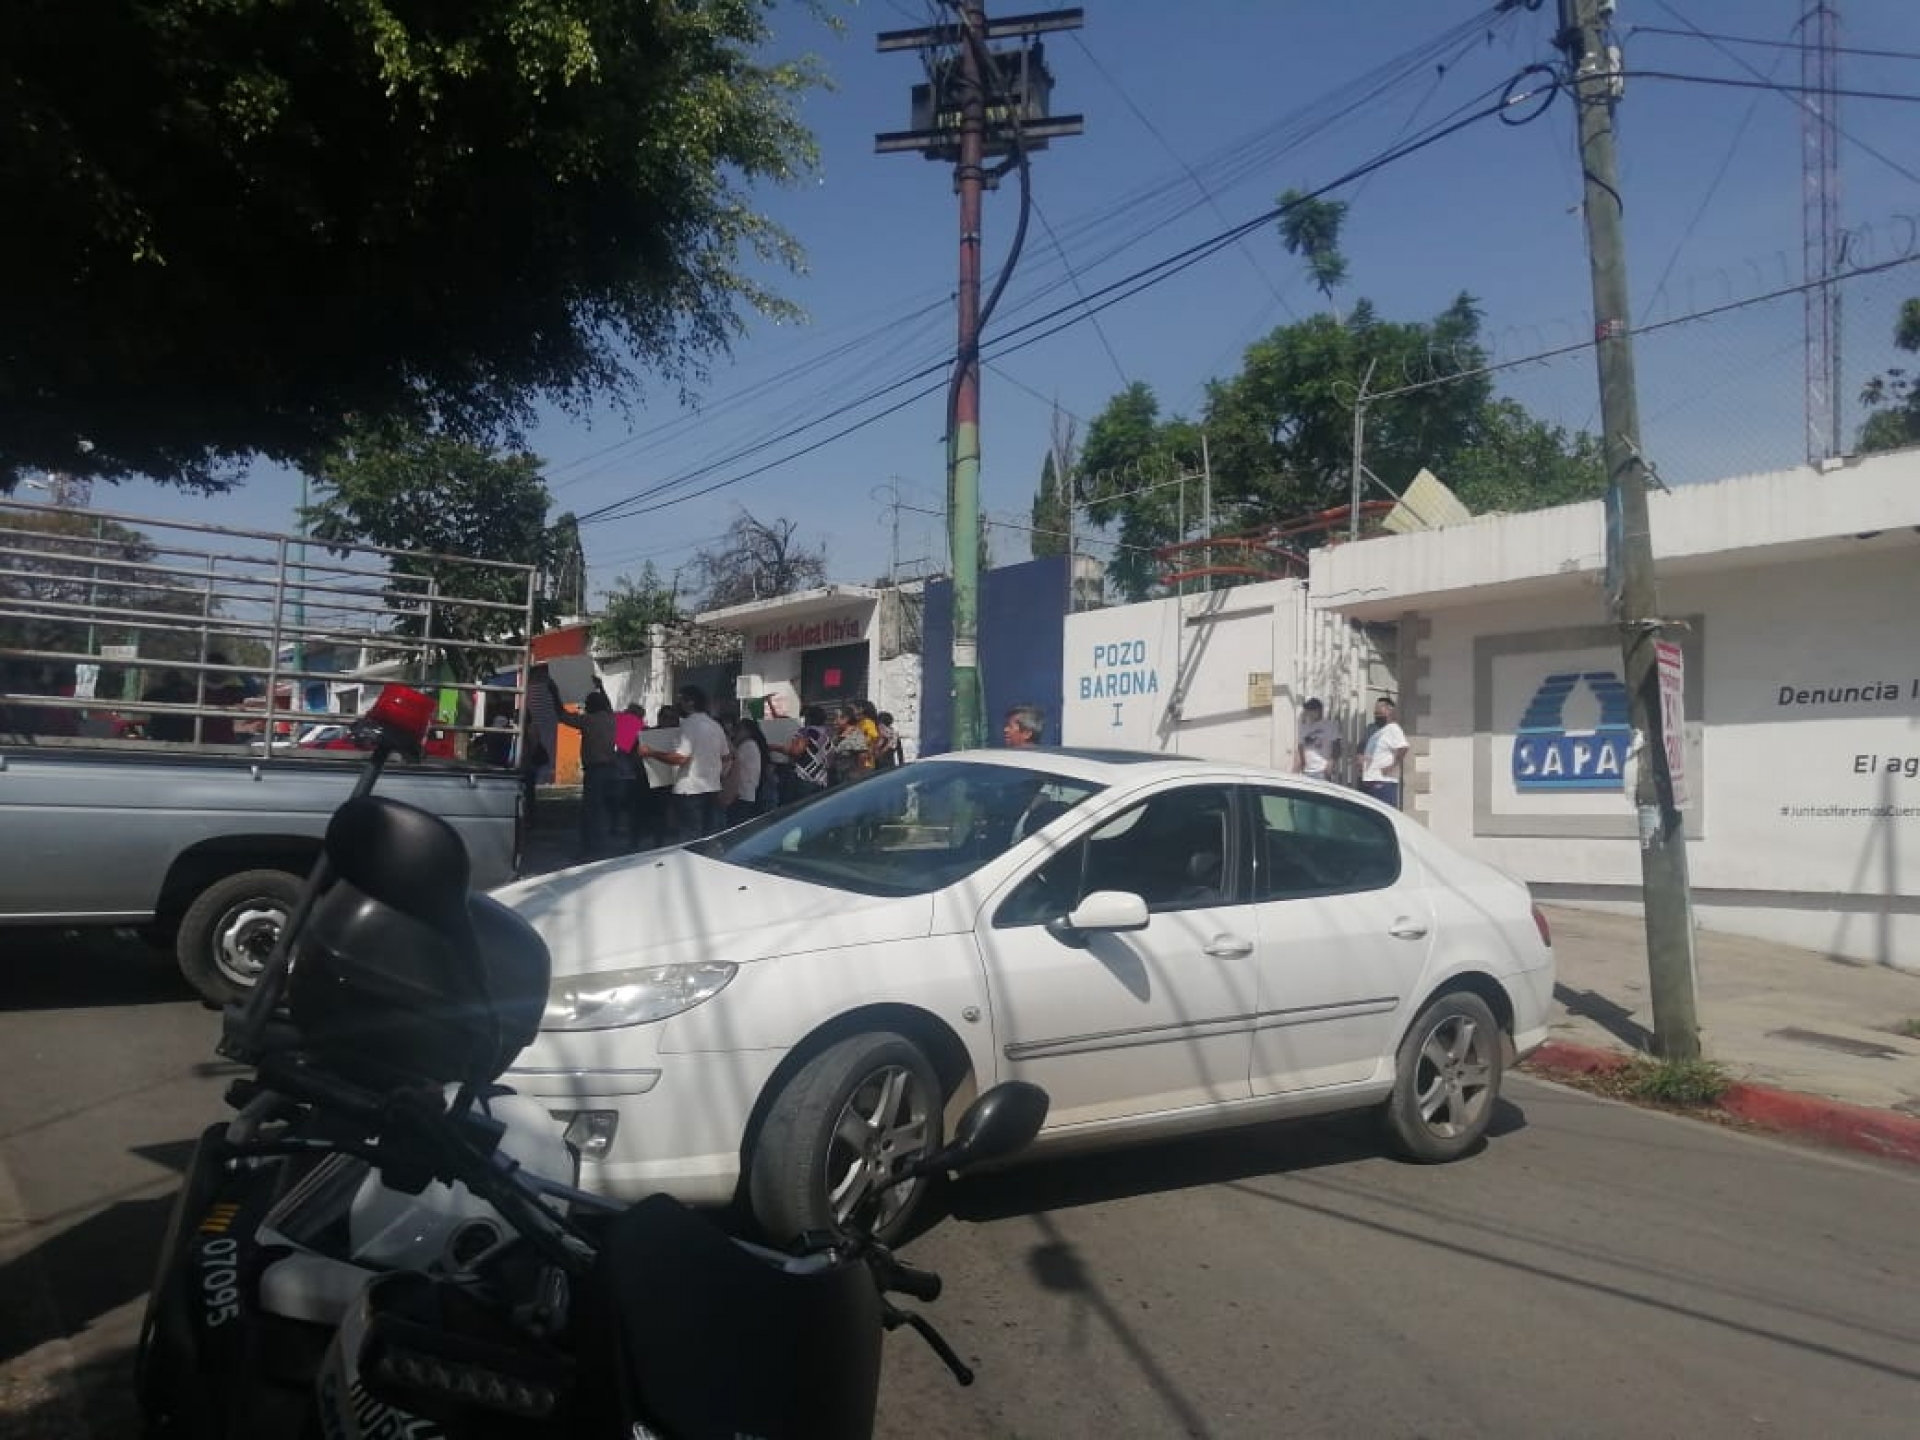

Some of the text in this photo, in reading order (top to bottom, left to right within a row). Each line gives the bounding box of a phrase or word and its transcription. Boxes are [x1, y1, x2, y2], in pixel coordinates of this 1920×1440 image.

[1094, 640, 1146, 669] POZO
[1079, 668, 1159, 700] BARONA
[1778, 681, 1899, 706] Denuncia
[1112, 702, 1123, 726] I
[1520, 742, 1634, 776] SAPA
[1854, 754, 1877, 773] El
[202, 1238, 240, 1328] 07095
